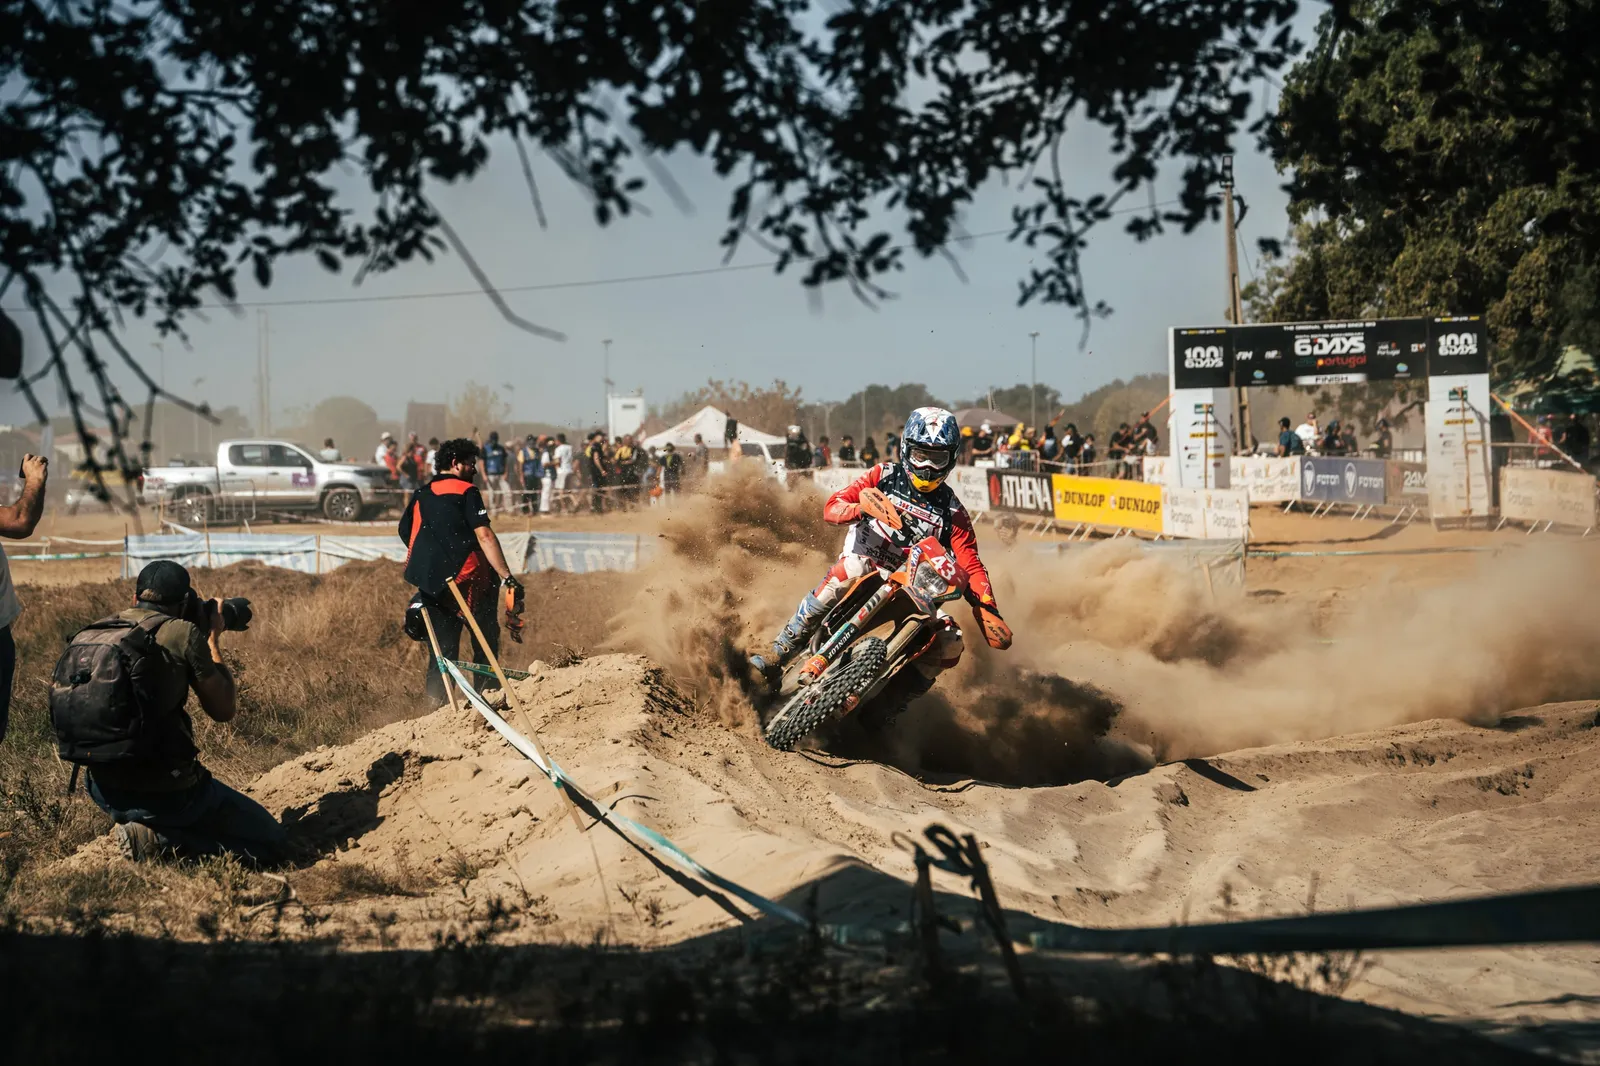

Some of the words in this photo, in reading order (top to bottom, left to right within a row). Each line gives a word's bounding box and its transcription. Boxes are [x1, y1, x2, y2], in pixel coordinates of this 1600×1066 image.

[1439, 333, 1472, 346] 100
[1185, 346, 1219, 359] 100
[1316, 474, 1340, 486] FOTON
[1358, 475, 1384, 489] FOTON
[1404, 471, 1428, 487] 24M
[1001, 475, 1053, 511] ATHENA
[1063, 490, 1105, 507] DUNLOP
[1118, 496, 1160, 515] DUNLOP
[931, 556, 956, 580] 43
